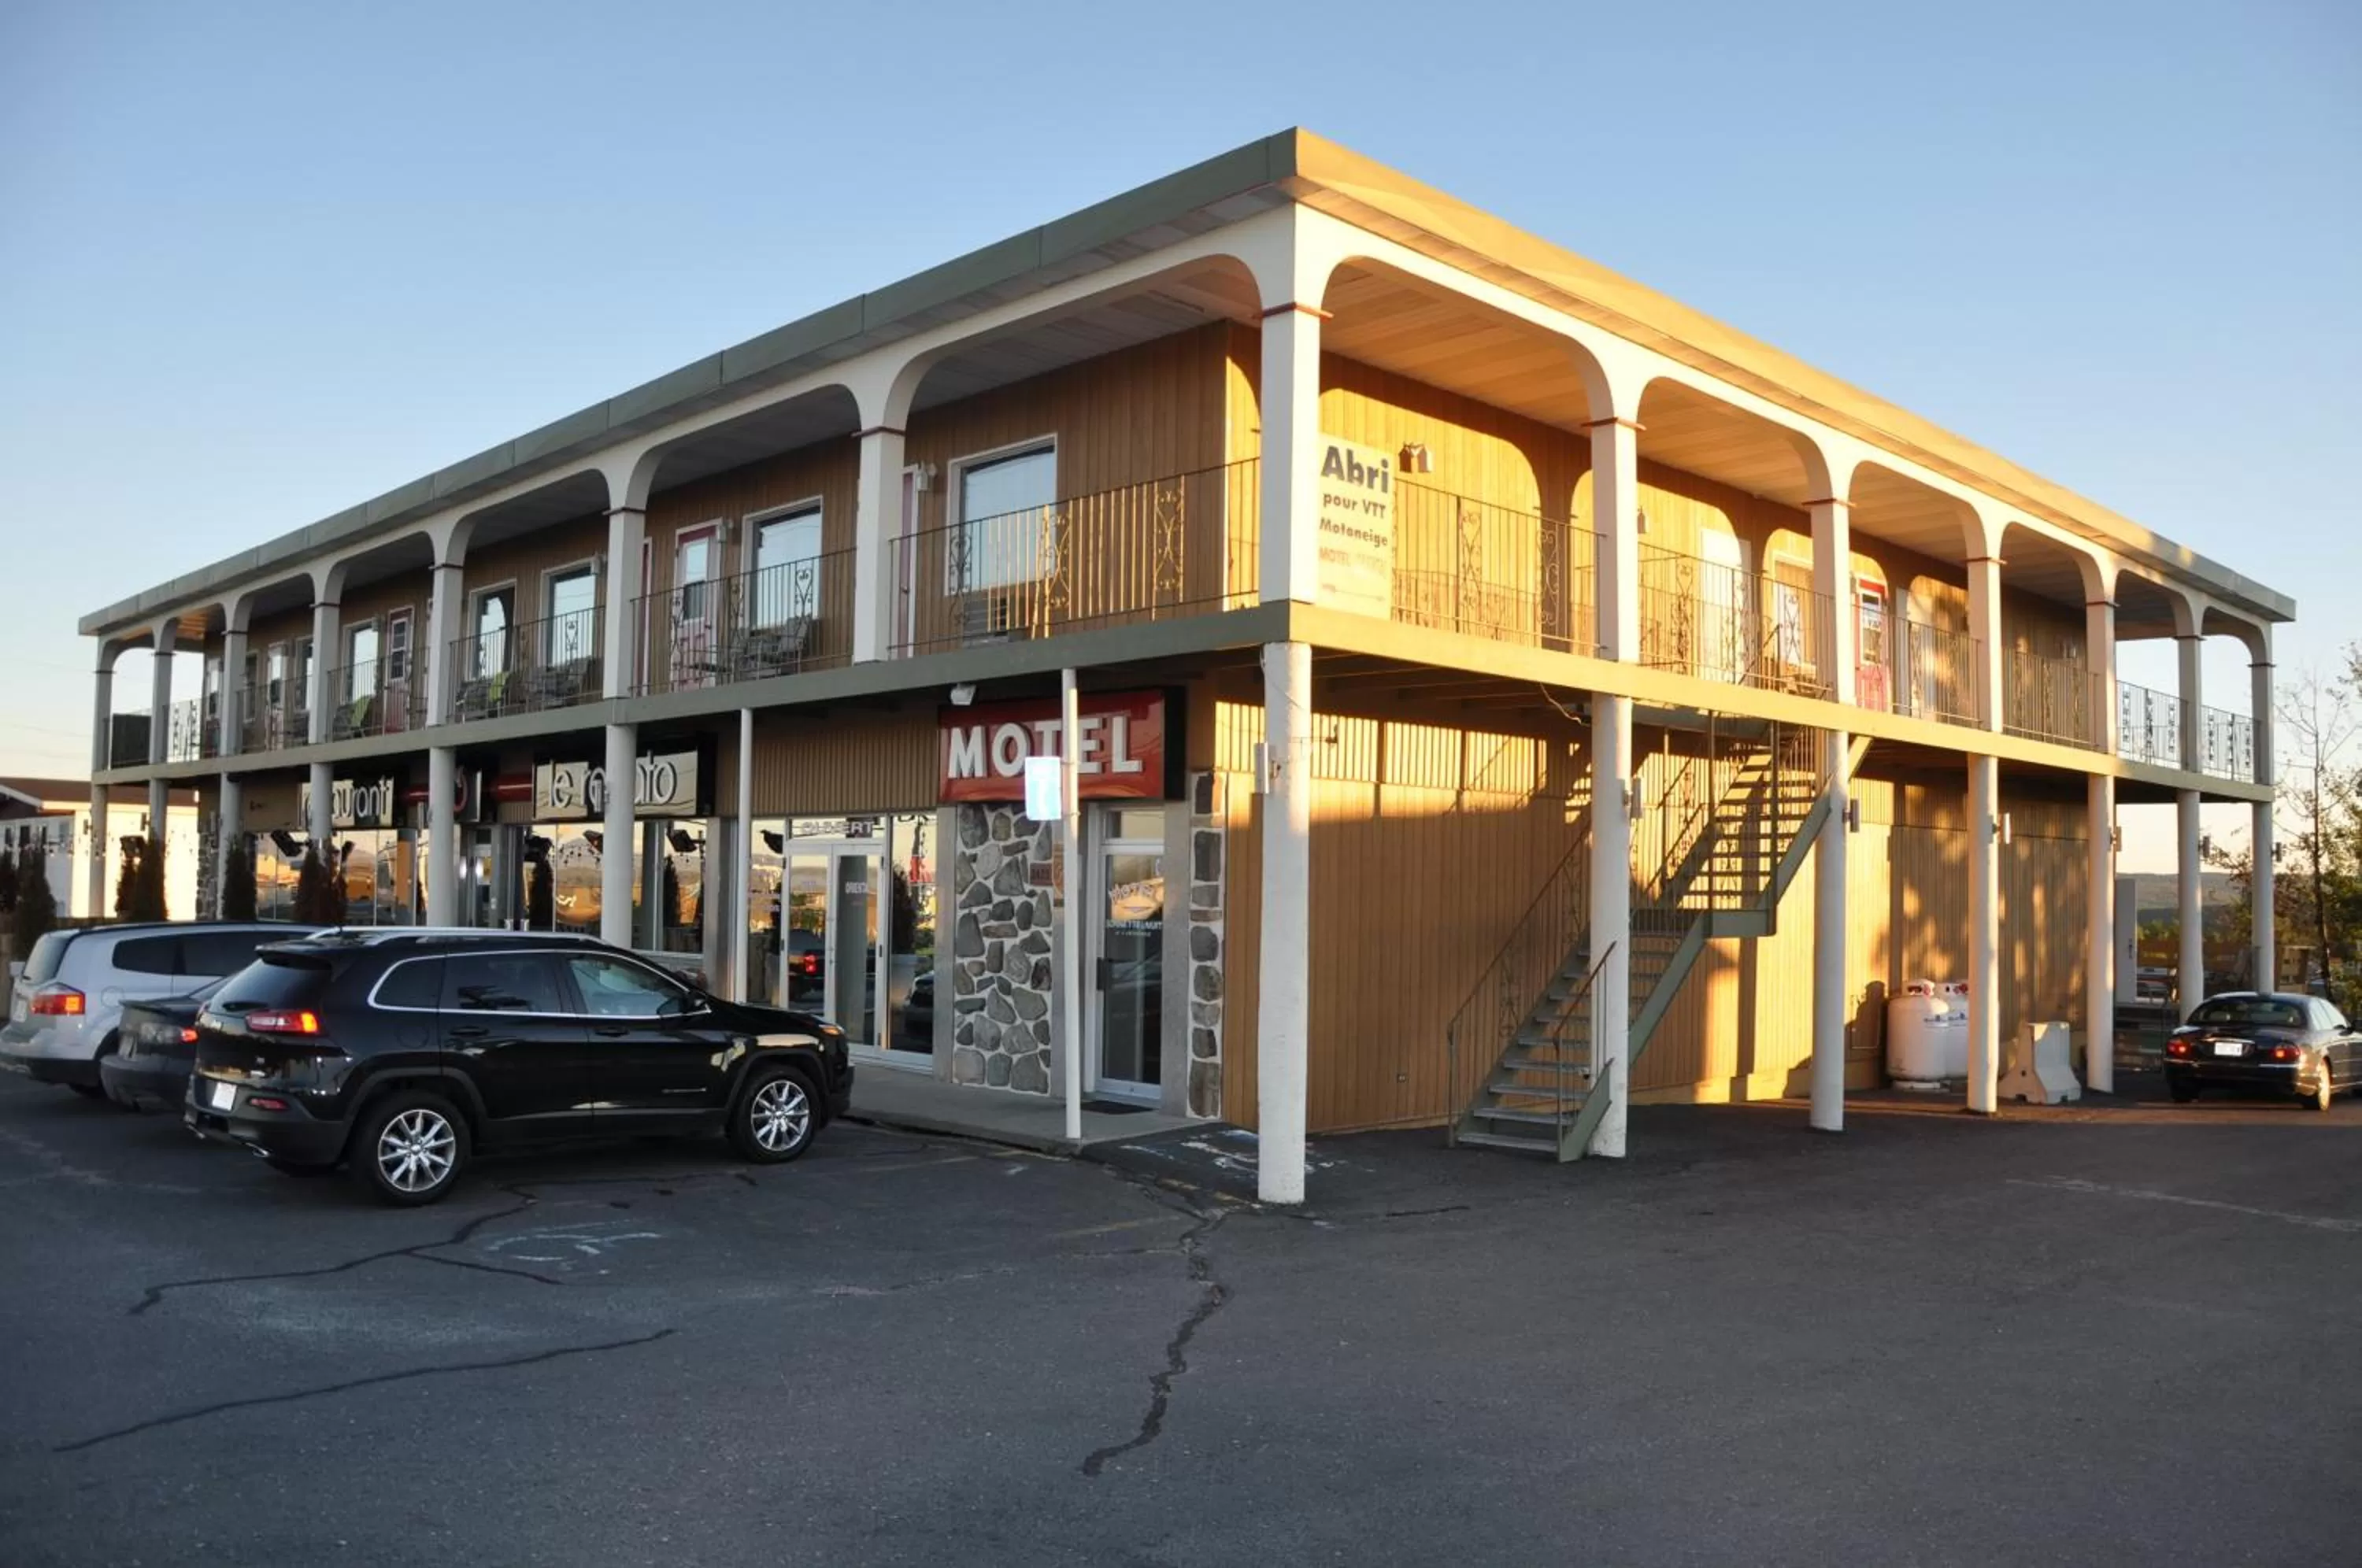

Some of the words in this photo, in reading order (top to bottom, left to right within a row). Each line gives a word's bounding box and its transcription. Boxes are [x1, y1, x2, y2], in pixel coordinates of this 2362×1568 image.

[1320, 445, 1389, 494] Abri
[1323, 493, 1358, 512] pour
[1362, 498, 1386, 519] VTT
[1319, 516, 1388, 549] Motoneige
[947, 714, 1143, 778] MOTEL
[302, 775, 387, 818] raurant
[550, 760, 572, 808] le
